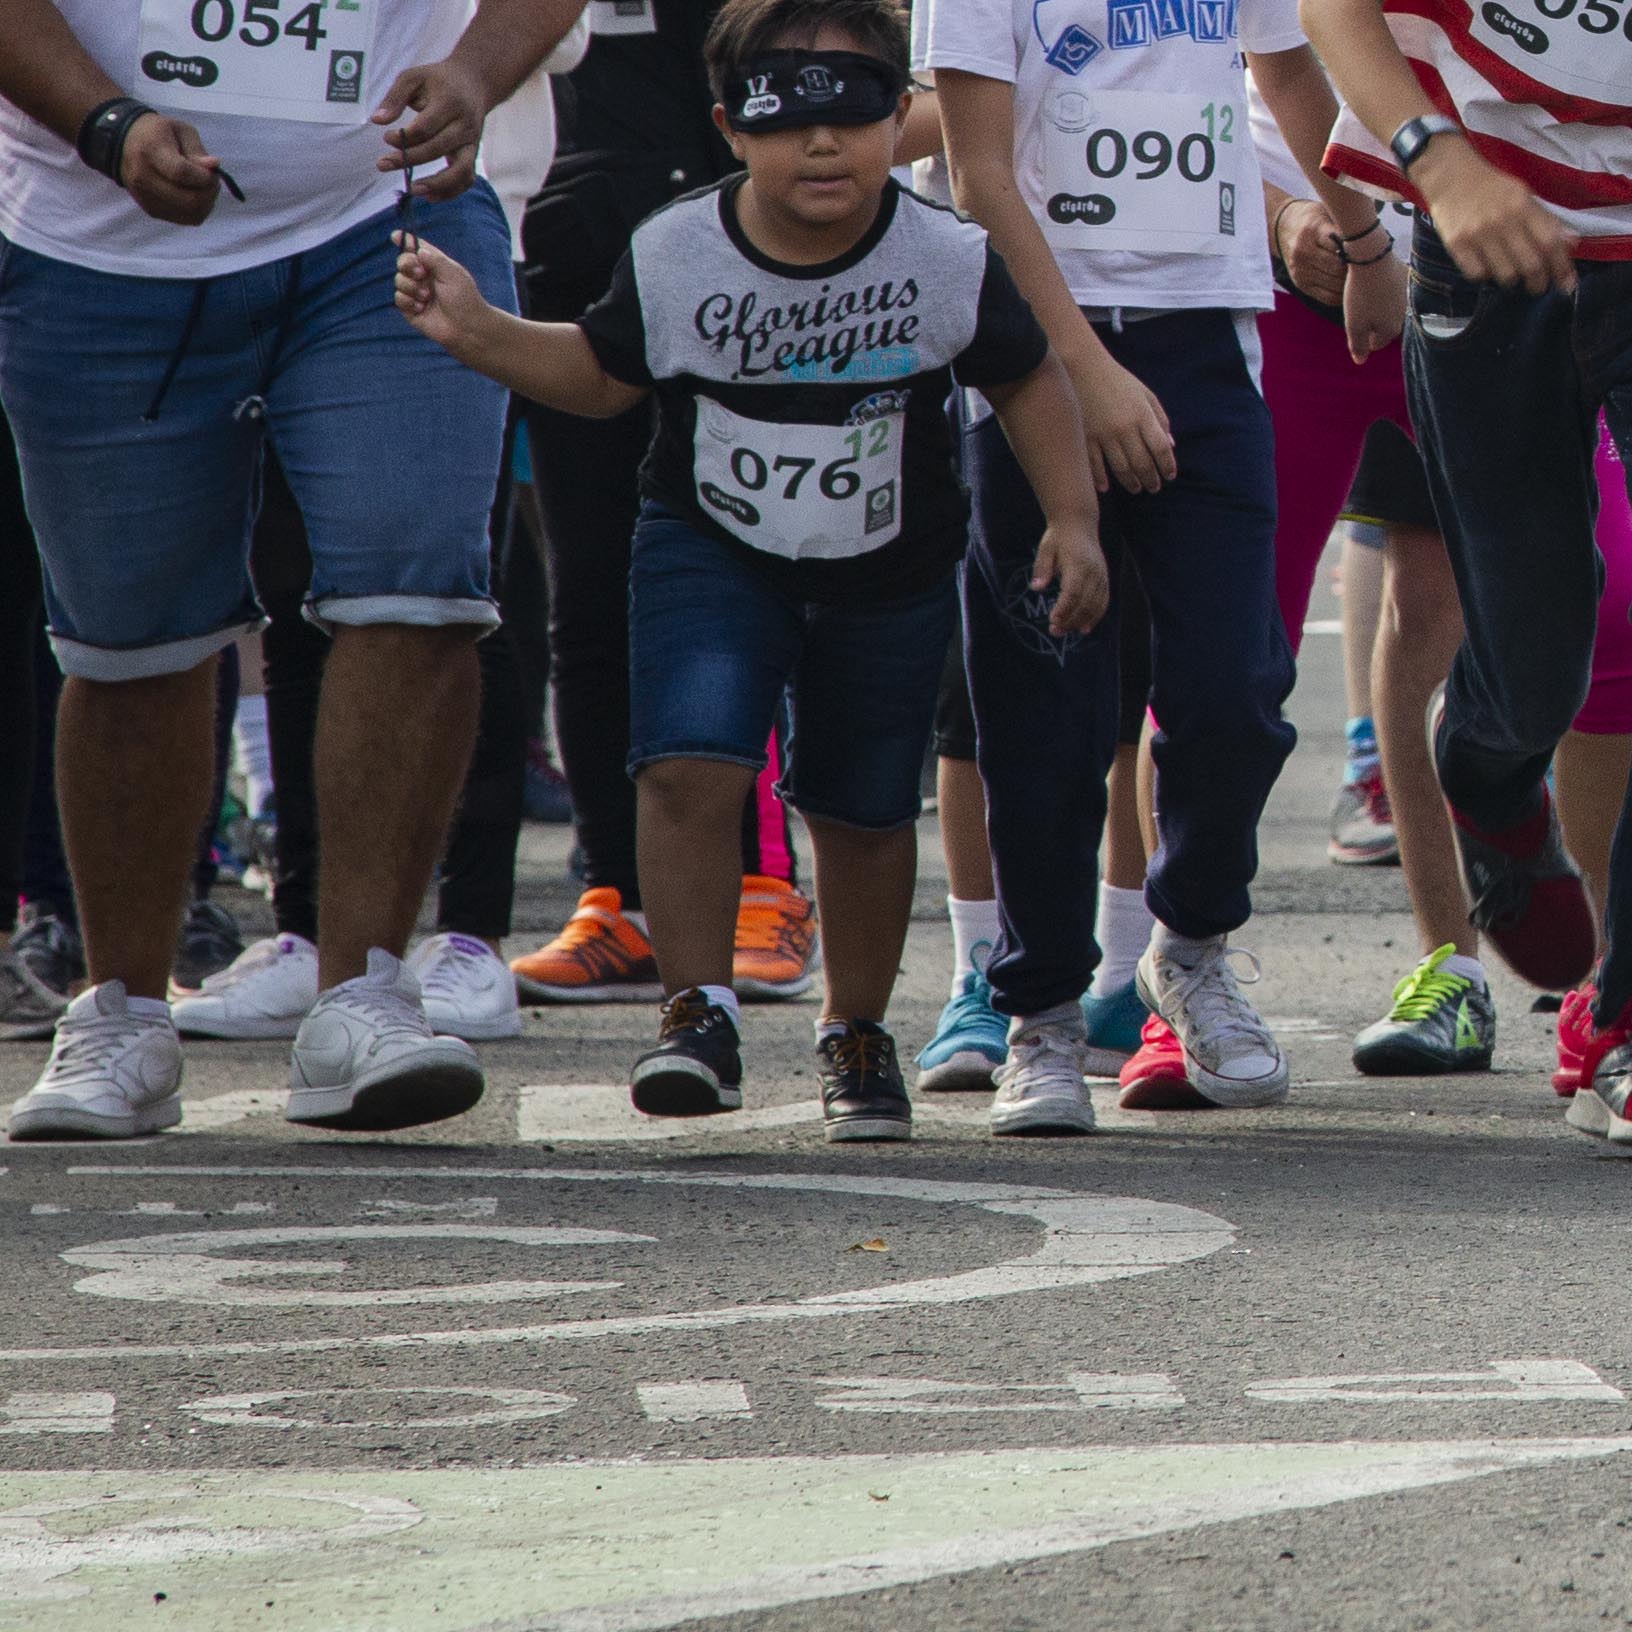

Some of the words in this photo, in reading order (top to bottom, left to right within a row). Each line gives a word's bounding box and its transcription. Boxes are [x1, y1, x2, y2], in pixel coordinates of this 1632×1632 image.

[1201, 102, 1234, 144] 12
[1086, 128, 1215, 182] 090
[695, 278, 919, 352] Glorious
[731, 315, 920, 380] League
[843, 419, 890, 461] 12
[730, 447, 861, 500] 076
